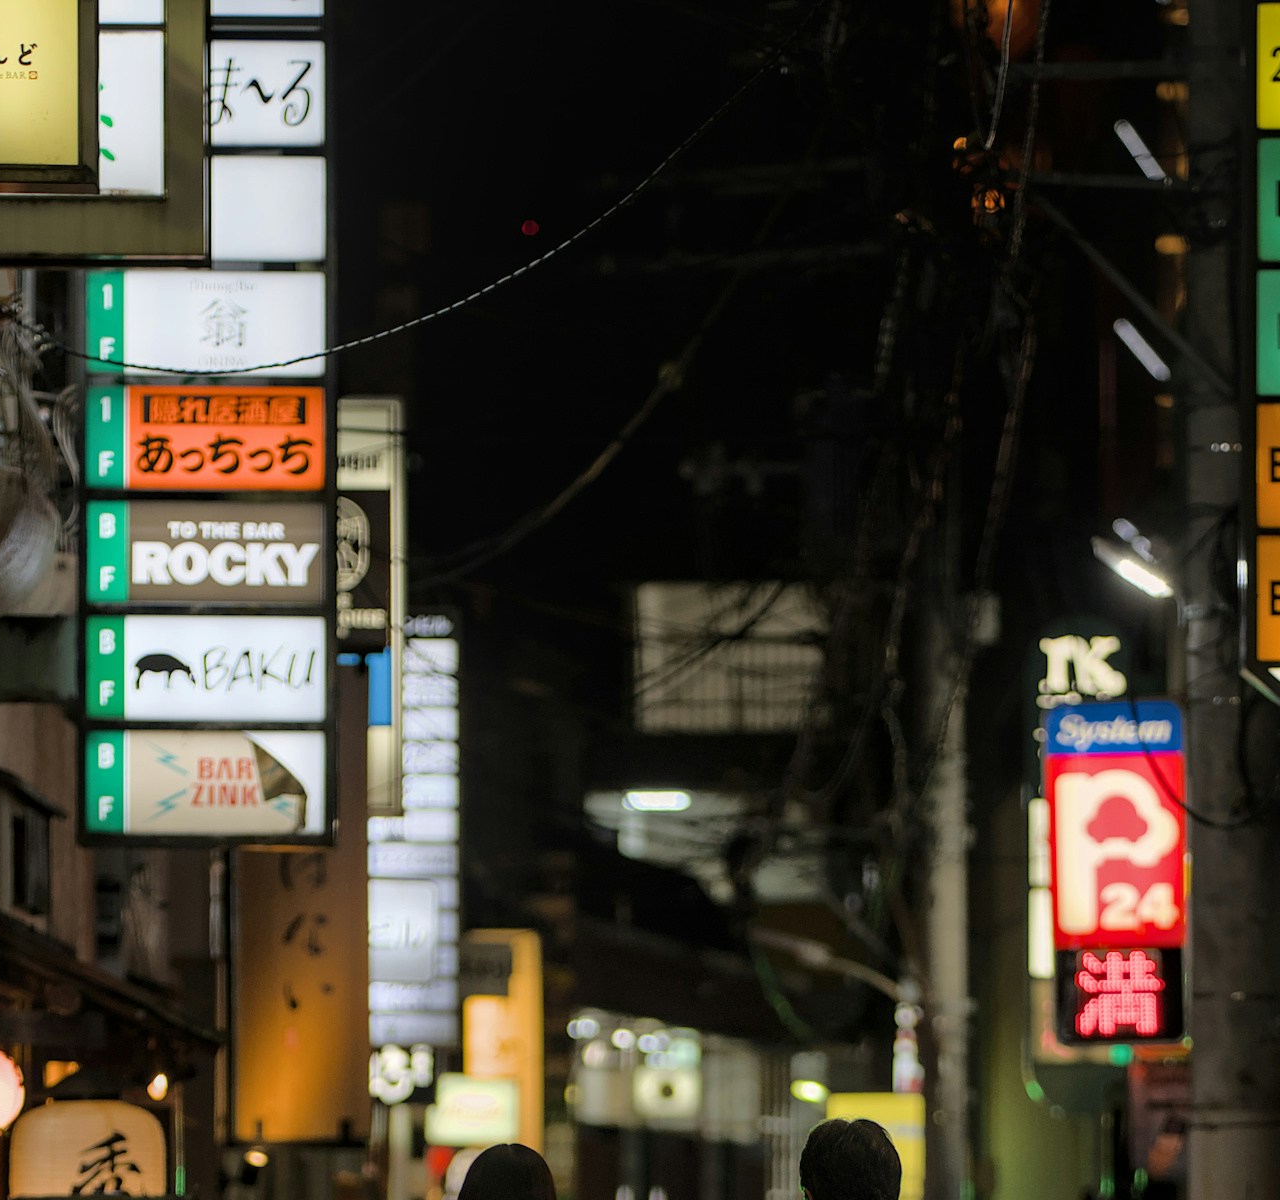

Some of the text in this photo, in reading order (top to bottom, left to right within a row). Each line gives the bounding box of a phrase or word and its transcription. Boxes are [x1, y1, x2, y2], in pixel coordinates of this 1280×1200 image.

[5, 71, 27, 80] BAR
[136, 433, 314, 475] あっちっち
[167, 521, 287, 541] TO THE BAR
[131, 541, 320, 586] ROCKY
[203, 646, 317, 692] BAKU
[1055, 713, 1174, 752] System
[196, 757, 256, 780] BAR
[190, 784, 261, 807] ZINK
[1099, 881, 1180, 934] 24
[1074, 949, 1167, 1039] 満
